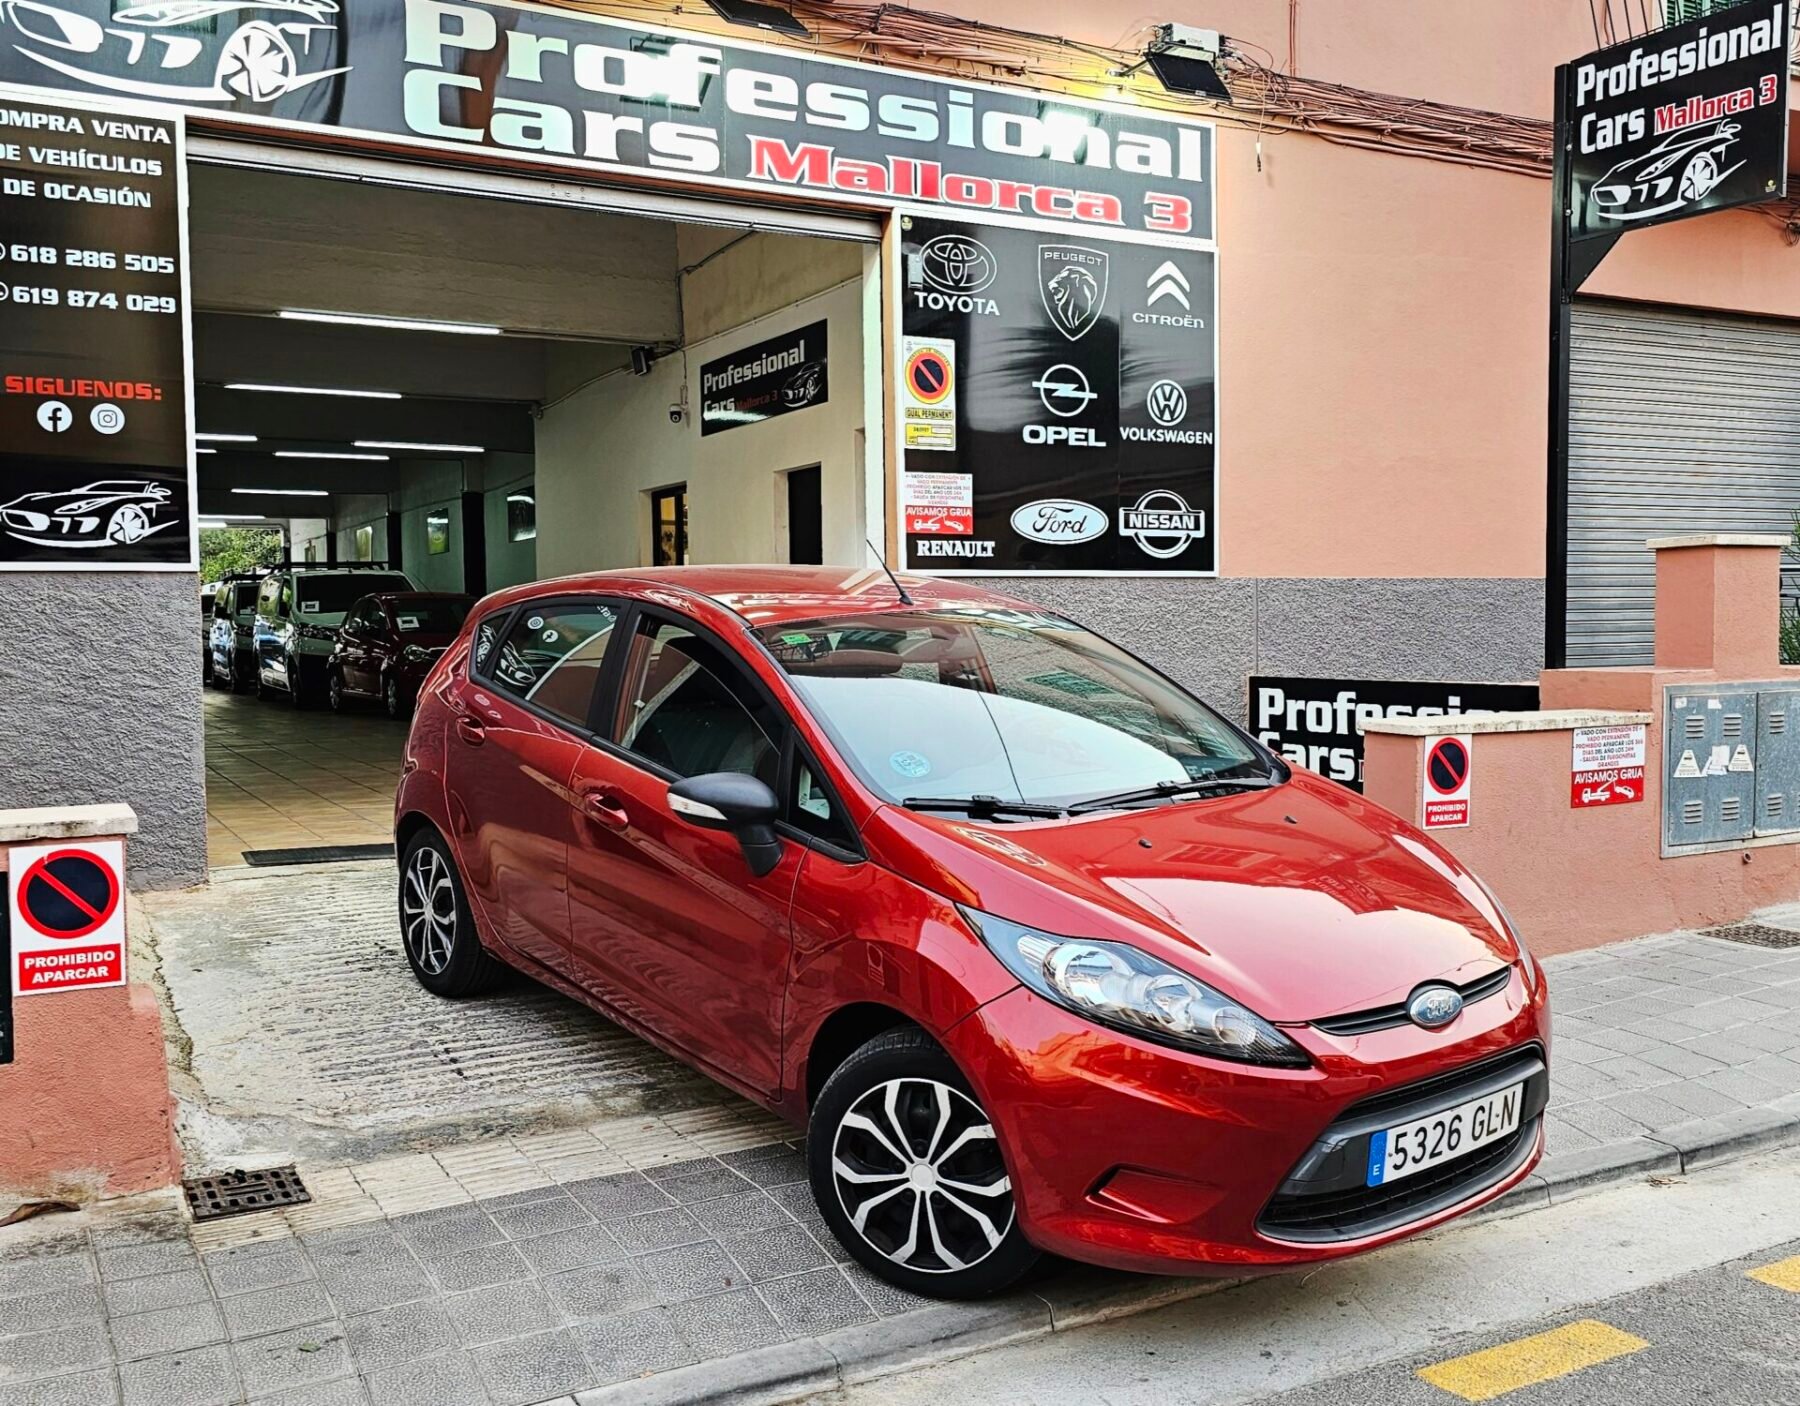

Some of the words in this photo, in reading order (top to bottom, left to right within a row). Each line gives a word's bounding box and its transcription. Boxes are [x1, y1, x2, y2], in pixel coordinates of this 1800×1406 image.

[1577, 3, 1783, 106] Professional
[404, 0, 1202, 181] Professional
[1580, 108, 1645, 154] Cars
[1653, 87, 1755, 136] Mallorca
[1759, 74, 1778, 106] 3
[91, 120, 171, 144] VENTA
[28, 147, 162, 176] VEHÍCULOS
[403, 68, 721, 173] Cars
[745, 133, 1126, 226] Mallorca
[1143, 191, 1193, 233] 3
[3, 178, 36, 196] DE
[44, 182, 151, 208] OCASIÓN
[10, 244, 57, 264] 618
[65, 249, 116, 269] 286
[125, 254, 175, 273] 505
[1044, 251, 1103, 266] PEUGEOT
[13, 286, 59, 305] 619
[67, 290, 118, 309] 874
[126, 295, 176, 313] 029
[914, 291, 1000, 316] TOYOTA
[703, 339, 806, 395] Professional
[5, 376, 162, 400] SIGUENOS:
[1022, 424, 1107, 447] OPEL
[1119, 426, 1213, 445] VOLKSWAGEN
[906, 507, 948, 516] AVISAMOS
[949, 508, 972, 517] GRUA
[1031, 506, 1087, 534] Ford
[1129, 512, 1196, 531] NISSAN
[916, 540, 995, 557] RENAULT
[1574, 769, 1619, 785] AVISAMOS
[1620, 767, 1644, 780] GRUA
[1427, 803, 1466, 813] PROHIBIDO
[1430, 813, 1463, 823] APARCAR
[24, 949, 116, 970] PROHIBIDO
[32, 965, 109, 984] APARCAR
[1392, 1114, 1463, 1171] 5326
[1471, 1090, 1516, 1142] GLN
[1372, 1163, 1381, 1177] E
